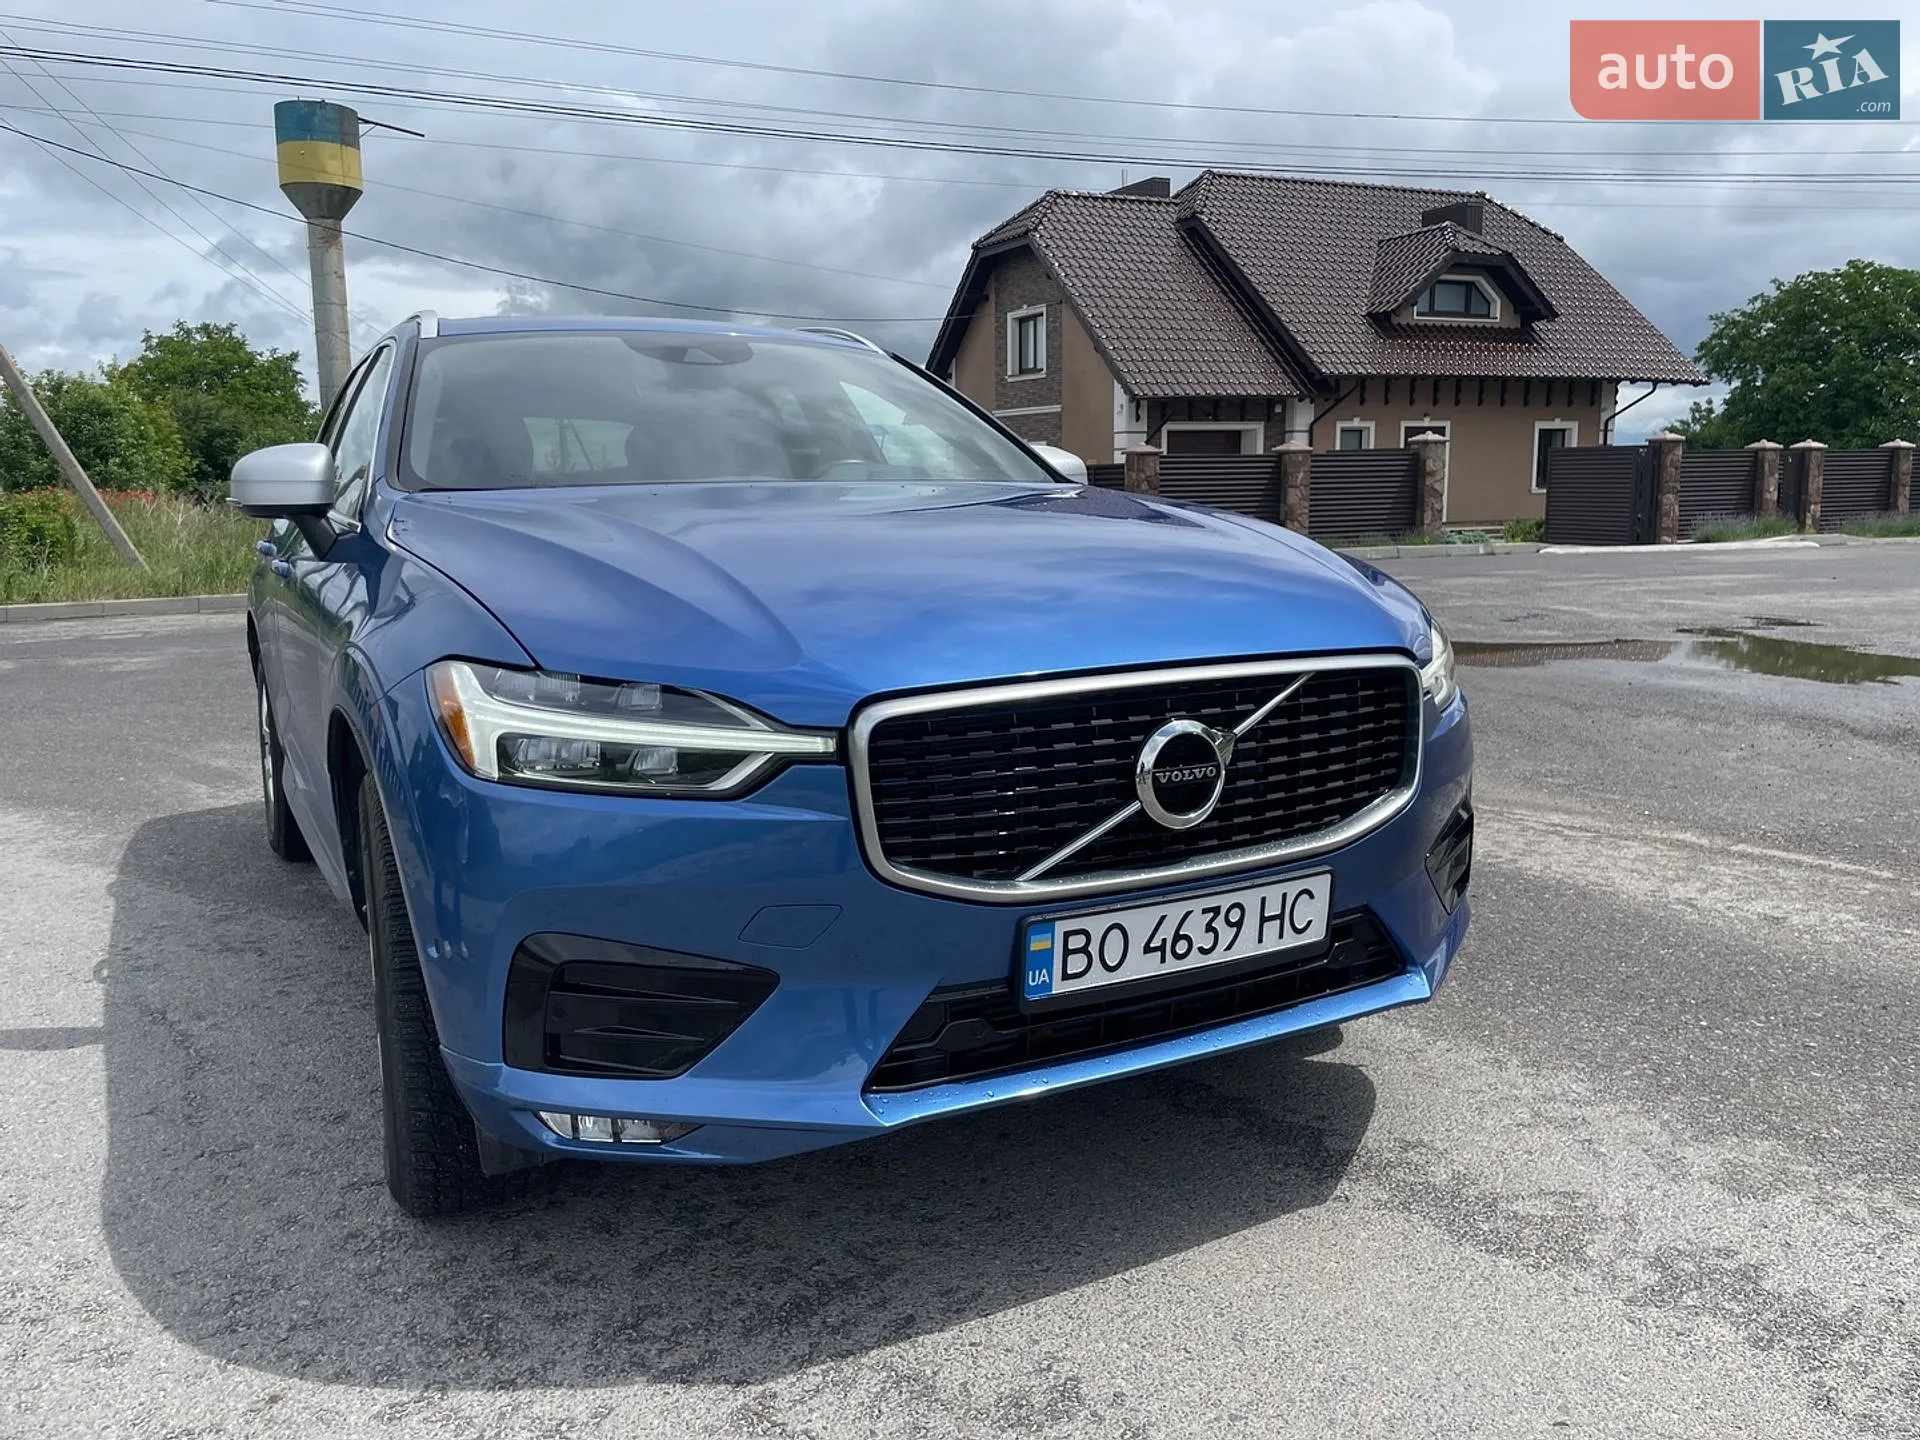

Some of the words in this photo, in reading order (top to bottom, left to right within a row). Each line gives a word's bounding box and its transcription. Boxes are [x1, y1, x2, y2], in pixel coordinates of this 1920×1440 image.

[1155, 767, 1217, 783] VOLVO
[1061, 922, 1129, 981] BO
[1143, 902, 1246, 963] 4639
[1257, 888, 1315, 944] HC
[1028, 970, 1050, 986] UA
